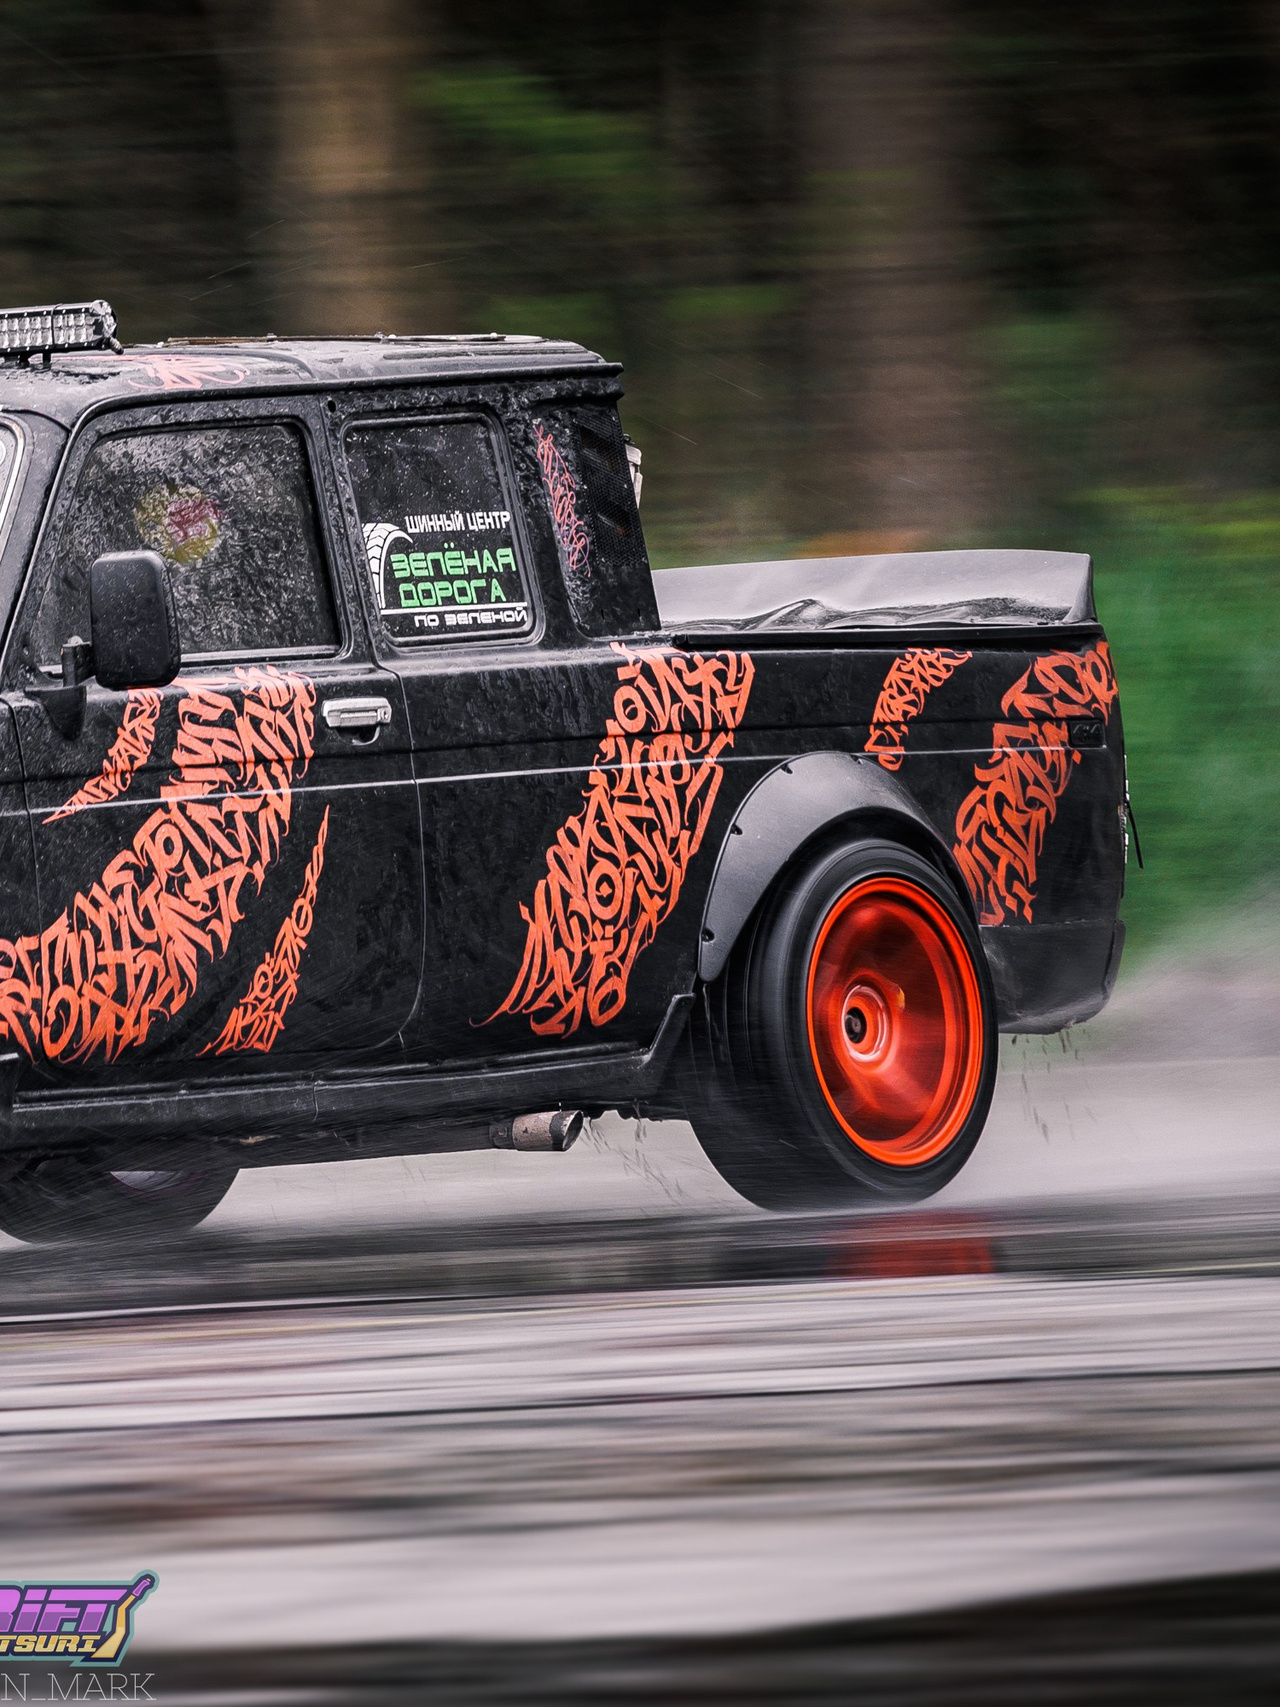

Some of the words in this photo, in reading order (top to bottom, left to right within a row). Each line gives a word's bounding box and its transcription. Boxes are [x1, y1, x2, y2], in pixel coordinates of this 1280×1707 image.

[404, 510, 465, 533] ШИННЫЙ
[466, 511, 511, 531] ЦЕНТР
[390, 542, 517, 578] ЗЕЛЁНАЯ
[399, 578, 507, 607] ДОРОГА
[414, 614, 439, 627] ПО
[444, 607, 528, 626] ЗЕЛЕНОЙ
